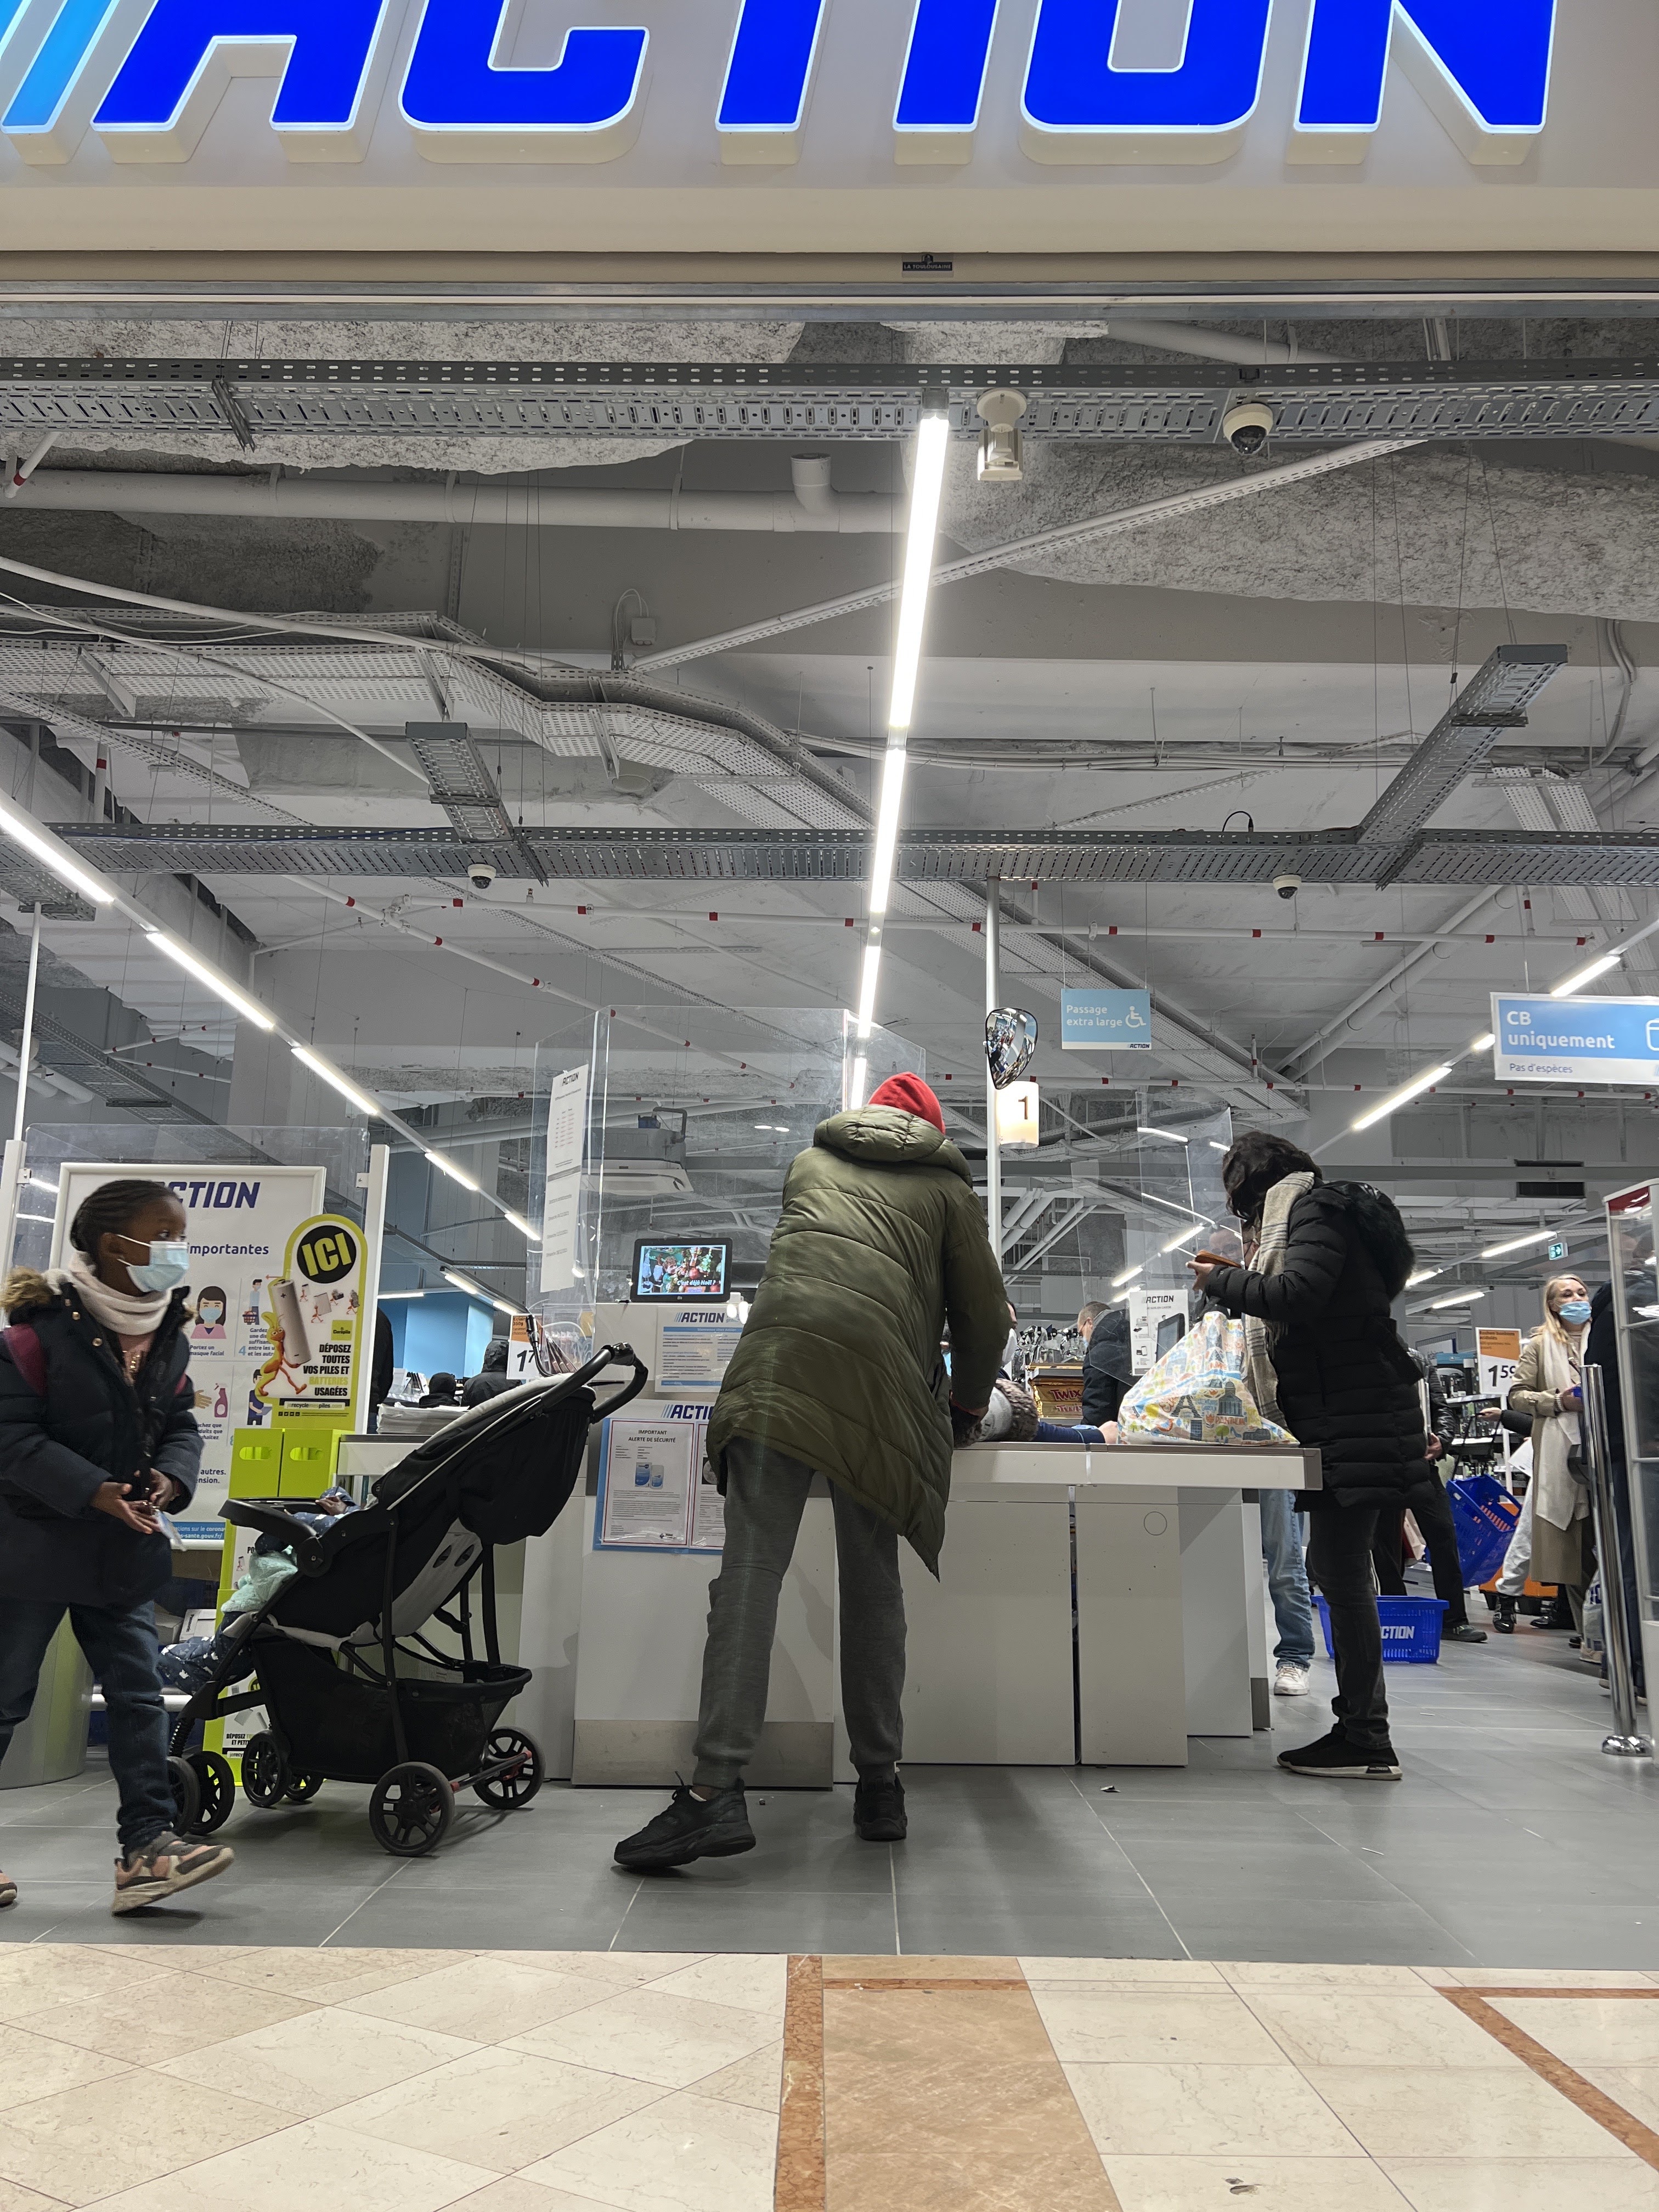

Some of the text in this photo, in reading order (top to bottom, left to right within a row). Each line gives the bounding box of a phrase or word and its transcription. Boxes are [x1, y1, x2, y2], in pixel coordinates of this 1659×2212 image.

[1066, 1005, 1107, 1015] Passage
[1066, 1017, 1123, 1028] extra large
[1506, 1011, 1532, 1025] CB
[1508, 1031, 1616, 1049] uniquement
[1509, 1063, 1573, 1074] Pas d'espèces
[562, 1071, 579, 1086] ACTION
[1018, 1096, 1028, 1120] 1
[301, 1232, 352, 1277] ICI
[1146, 1295, 1174, 1304] ACTION
[681, 1312, 725, 1323] ACTION
[238, 1346, 246, 1356] 4
[319, 1343, 351, 1353] DÉPOSEZ
[322, 1355, 350, 1363] TOUTES
[303, 1365, 349, 1374] VOS PILES ET
[309, 1376, 348, 1385] BATTERIES
[314, 1386, 347, 1396] USAGÉES
[186, 1614, 195, 1632] Panasonic
[1380, 1626, 1415, 1639] CTION
